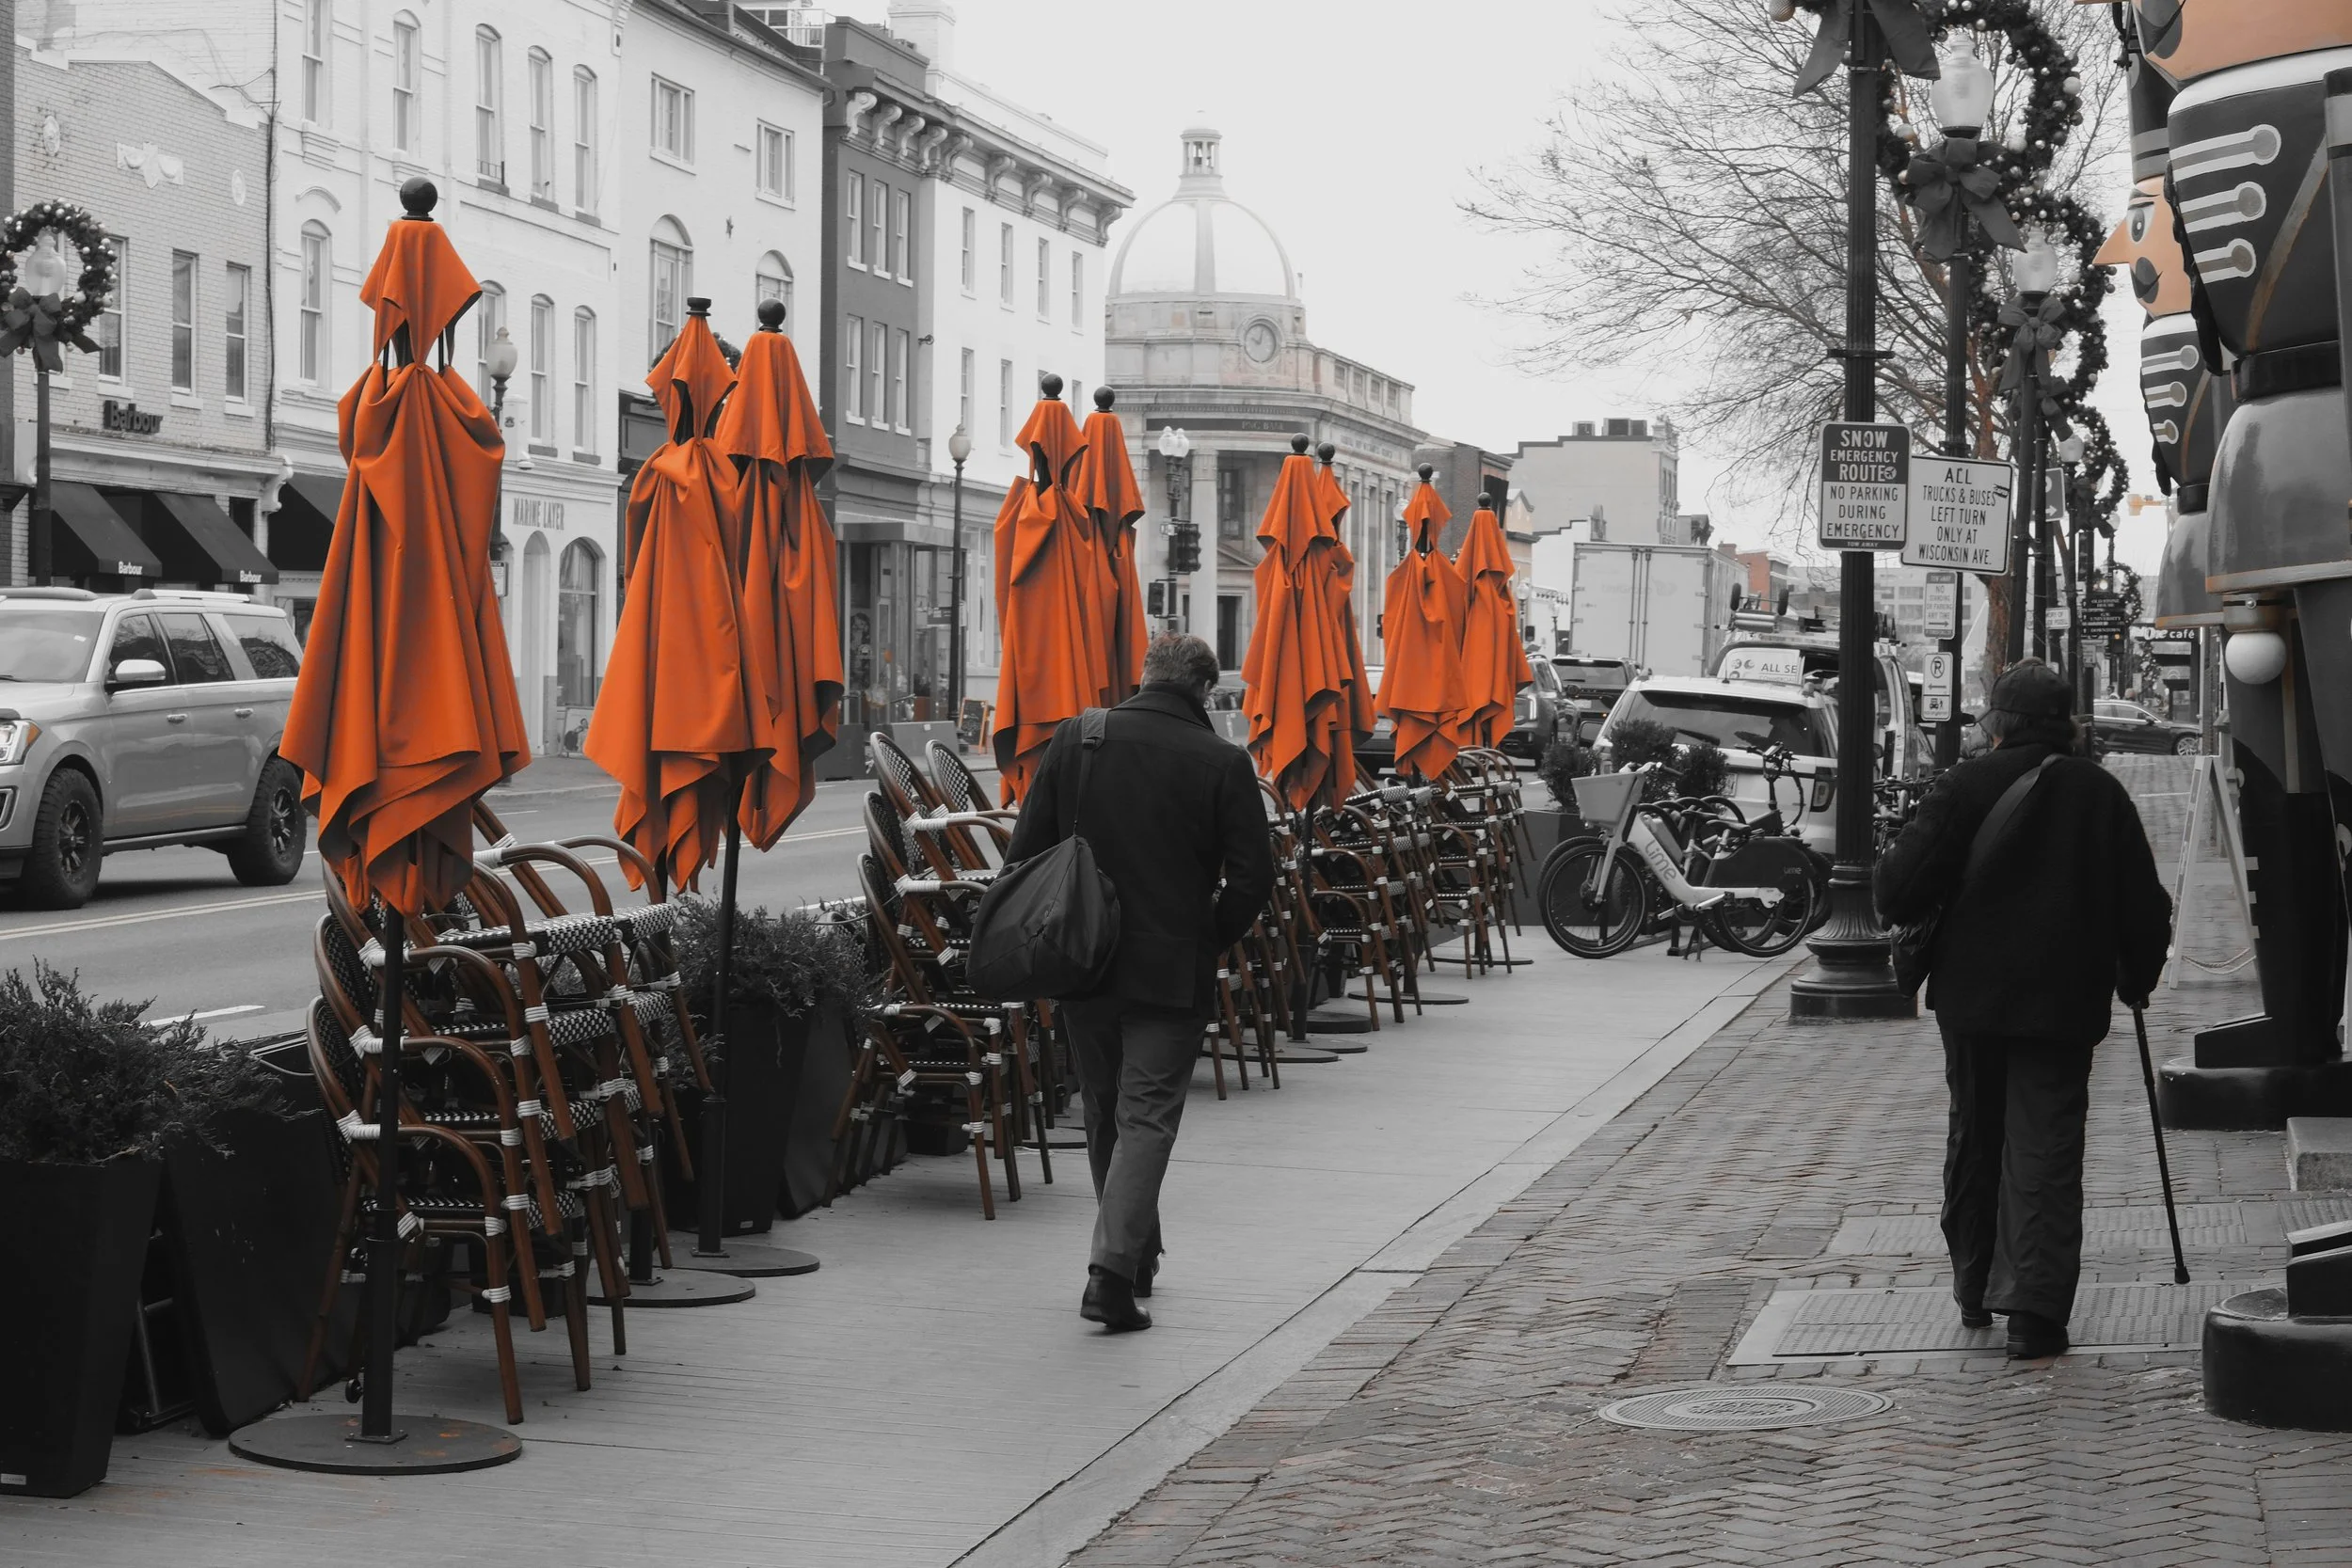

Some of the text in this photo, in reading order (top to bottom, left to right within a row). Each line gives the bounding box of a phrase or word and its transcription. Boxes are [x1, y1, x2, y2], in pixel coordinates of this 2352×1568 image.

[103, 399, 164, 436] Barbour
[1840, 430, 1888, 448] SNOW
[1830, 450, 1899, 464] EMERGENCY
[1839, 464, 1885, 482] ROUTE
[1945, 467, 1972, 484] ALL
[1830, 485, 1899, 501] NO PARKING
[1923, 485, 1996, 507] TRUCKS & BUSES
[513, 498, 564, 531] MARINE LAYER
[1838, 504, 1886, 520] DURING
[1931, 506, 1986, 526] LEFT TURN
[1827, 523, 1899, 539] EMERGENCY
[1937, 527, 1978, 544] ONLY AT
[1918, 545, 1992, 565] WISCONSIN AVE.
[119, 561, 142, 575] Barbour
[240, 570, 262, 583] Barbour
[1935, 585, 1945, 594] NO
[2169, 629, 2195, 639] café
[1761, 663, 1780, 673] ALL
[1645, 840, 1677, 881] Lime
